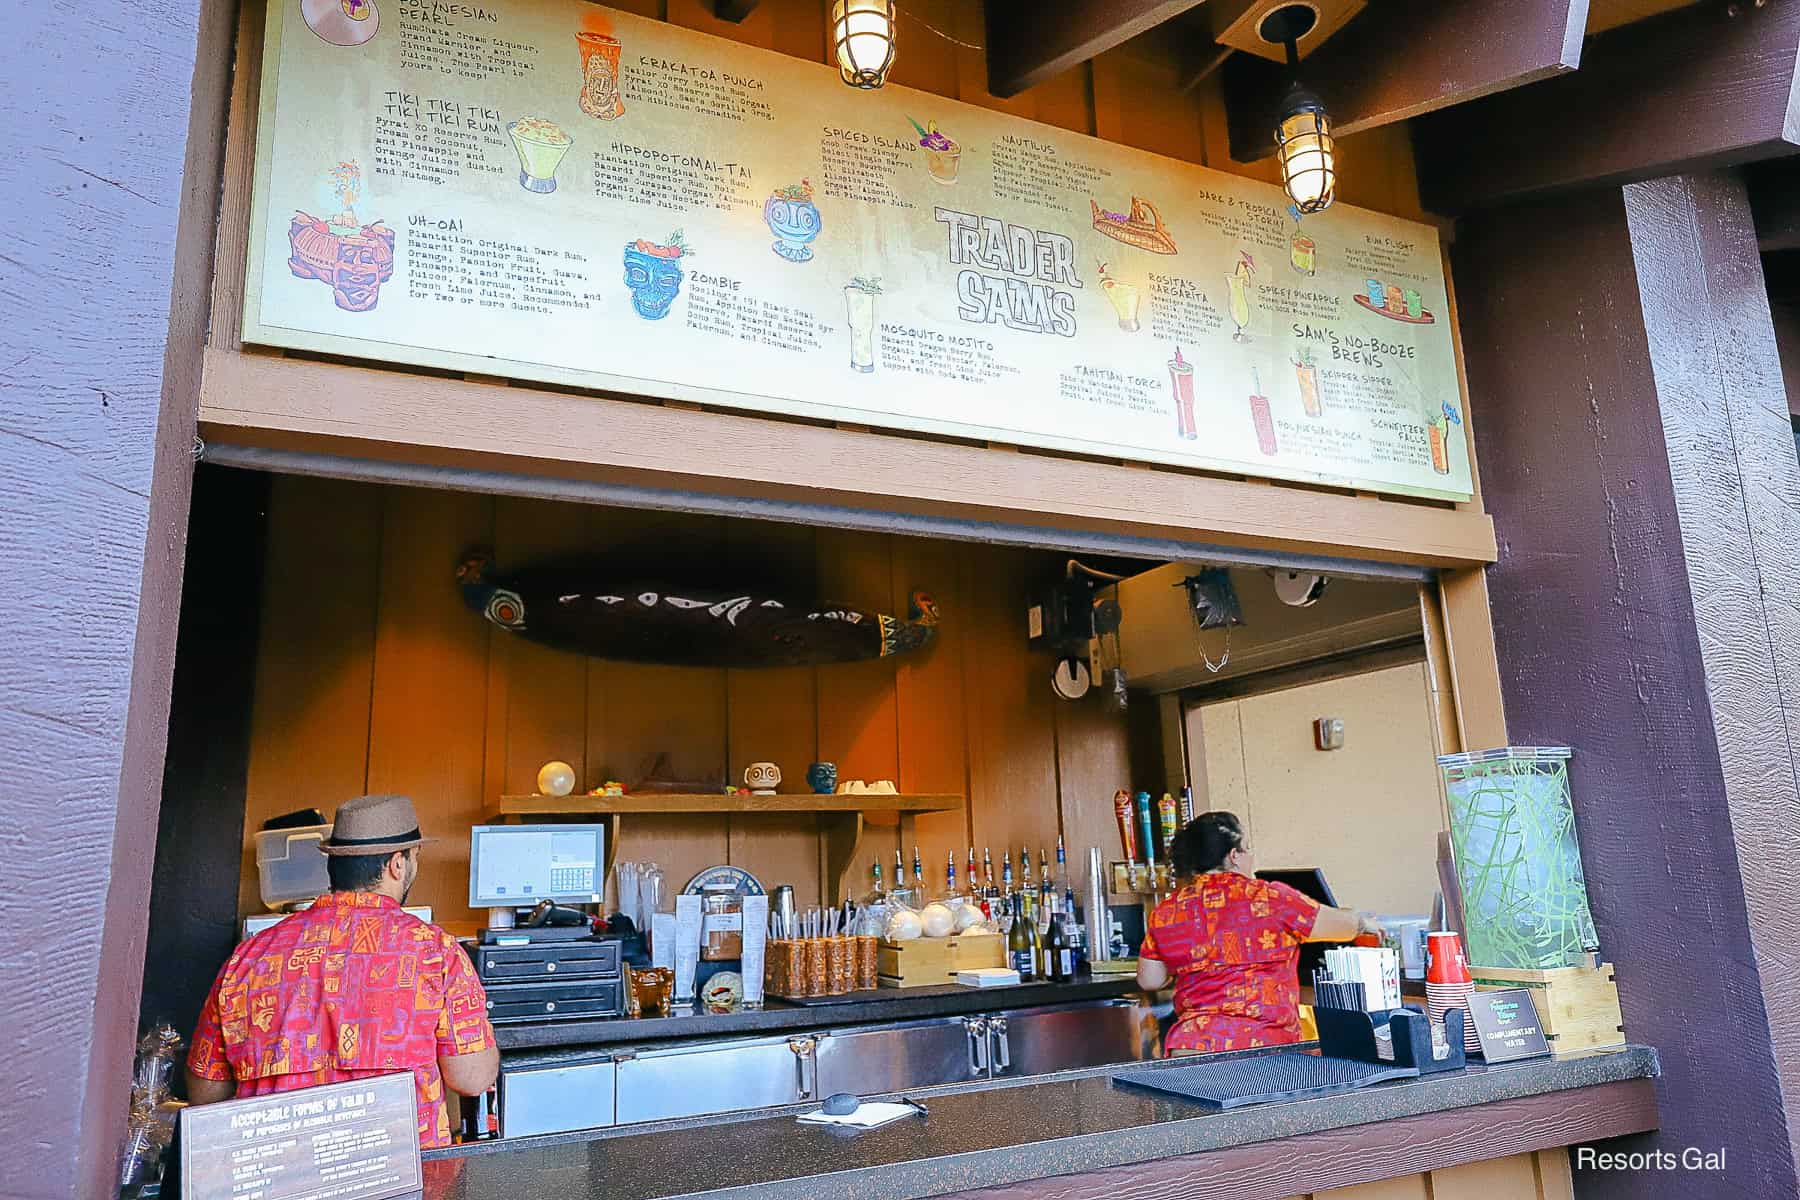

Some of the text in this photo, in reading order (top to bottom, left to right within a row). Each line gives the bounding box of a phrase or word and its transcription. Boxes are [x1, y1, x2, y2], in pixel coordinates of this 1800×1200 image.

[400, 8, 454, 26] PEARL
[400, 31, 432, 43] Grand
[494, 48, 511, 56] and
[400, 61, 433, 71] yours
[440, 66, 452, 74] to
[639, 56, 764, 91] KRAKATOA PUNCH
[625, 93, 642, 101] and
[384, 92, 500, 121] TIKI TIKI TIKI
[384, 105, 500, 134] TIKI TIKI RUM
[415, 134, 428, 142] of
[823, 127, 917, 152] SPICED ISLAND
[1002, 136, 1055, 154] NAUTILUS
[375, 138, 396, 146] and
[466, 153, 485, 161] and
[375, 146, 415, 160] Orange
[375, 157, 402, 167] with
[375, 167, 396, 175] and
[1199, 190, 1224, 203] DARK
[408, 216, 463, 232] UH-OA!
[408, 229, 473, 245] Plantation
[935, 207, 1083, 288] TRADER
[479, 270, 499, 278] and
[690, 271, 742, 291] ZOMBIE
[409, 290, 429, 299] for
[583, 293, 601, 301] and
[957, 270, 1076, 337] SAM'S
[881, 323, 993, 351] MOSQUITO MOJITO
[1292, 323, 1416, 359] SAM'S NO-BOOZE
[1487, 1027, 1536, 1040] COMPLIMENTARY
[1504, 1038, 1525, 1048] WATER
